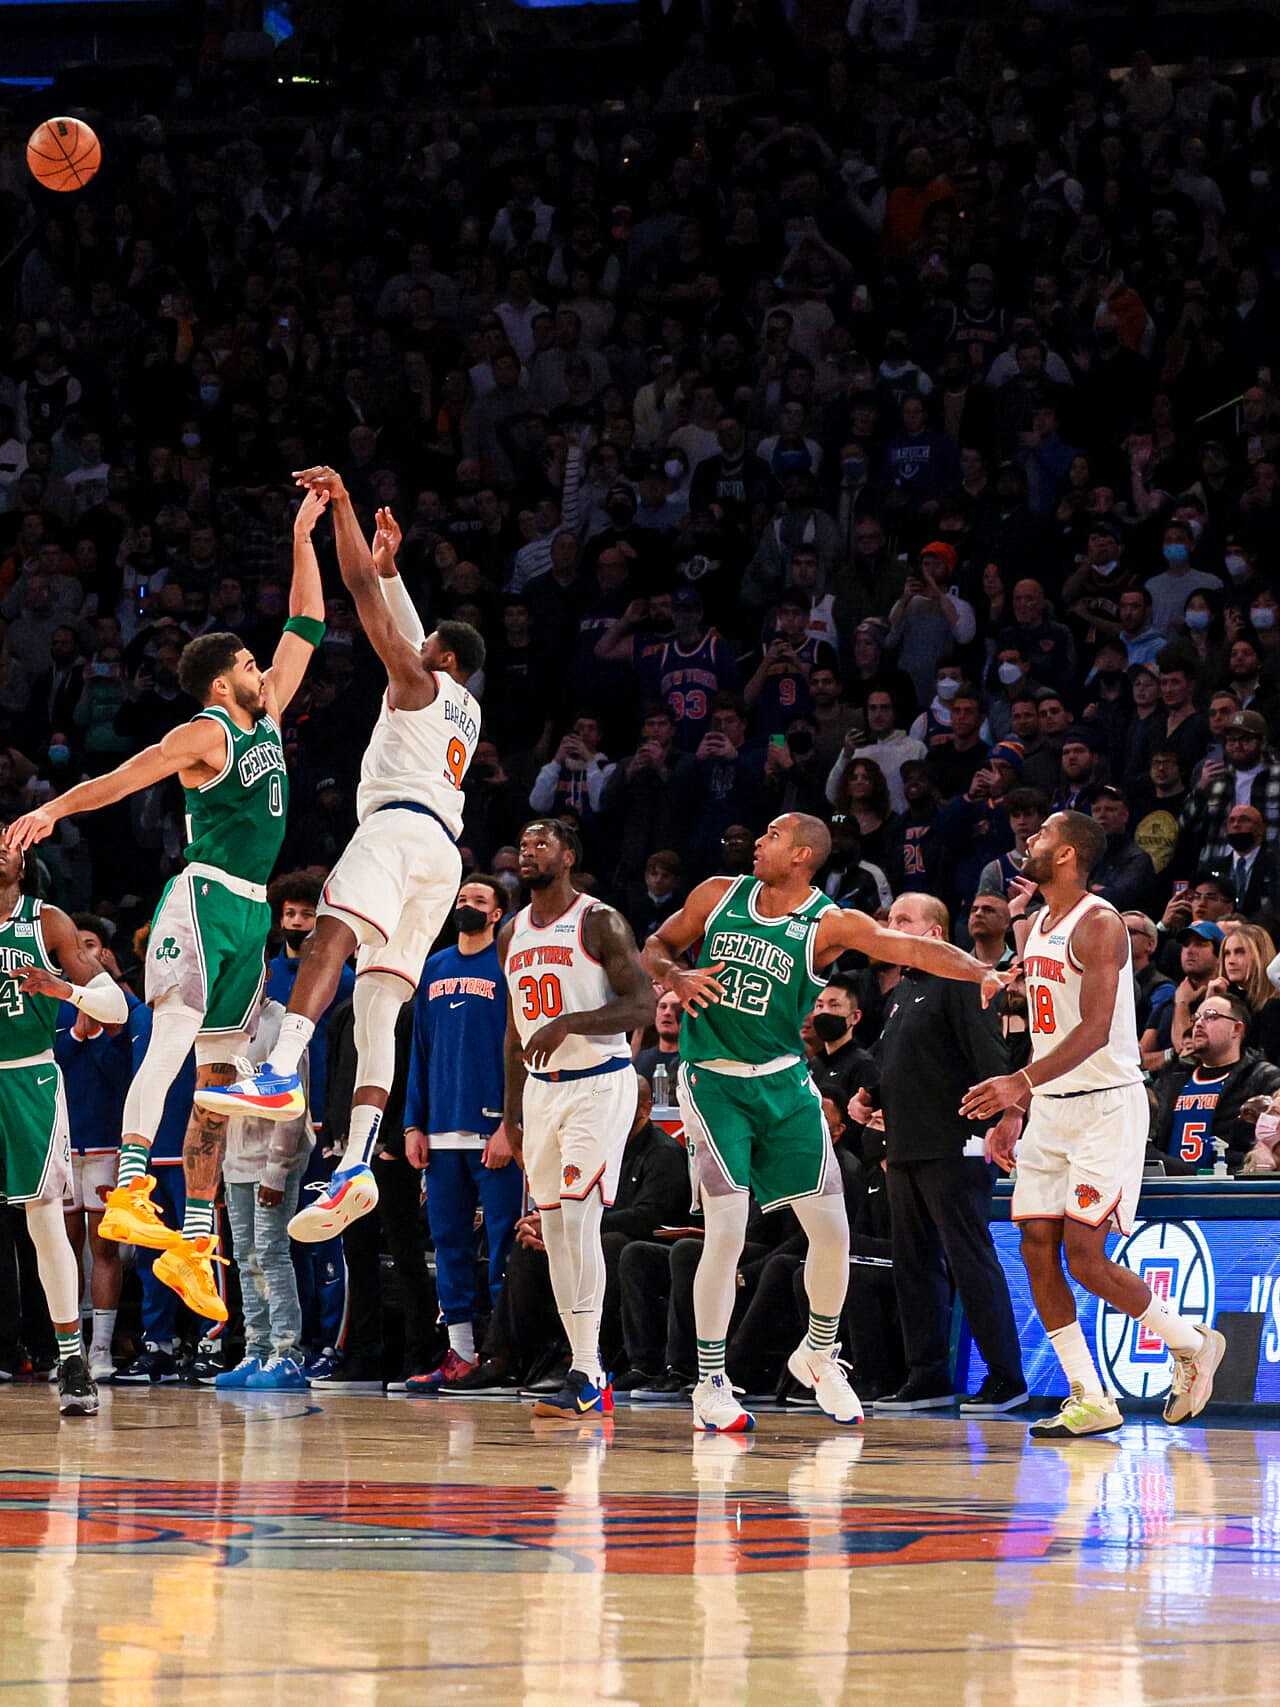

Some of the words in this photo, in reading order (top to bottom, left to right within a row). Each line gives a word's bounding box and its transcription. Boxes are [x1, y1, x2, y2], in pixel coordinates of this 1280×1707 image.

[779, 677, 797, 706] 9
[444, 736, 467, 790] 9
[269, 774, 283, 817] 0
[509, 948, 537, 976] NEW
[536, 945, 573, 967] YORK
[710, 932, 794, 985] CELTICS
[429, 977, 458, 1001] NEW
[457, 976, 497, 1000] YORK
[519, 973, 563, 1020] 30
[716, 966, 772, 1017] 42
[1029, 984, 1057, 1035] 18
[1173, 1094, 1195, 1111] EW
[1180, 1122, 1207, 1162] 5
